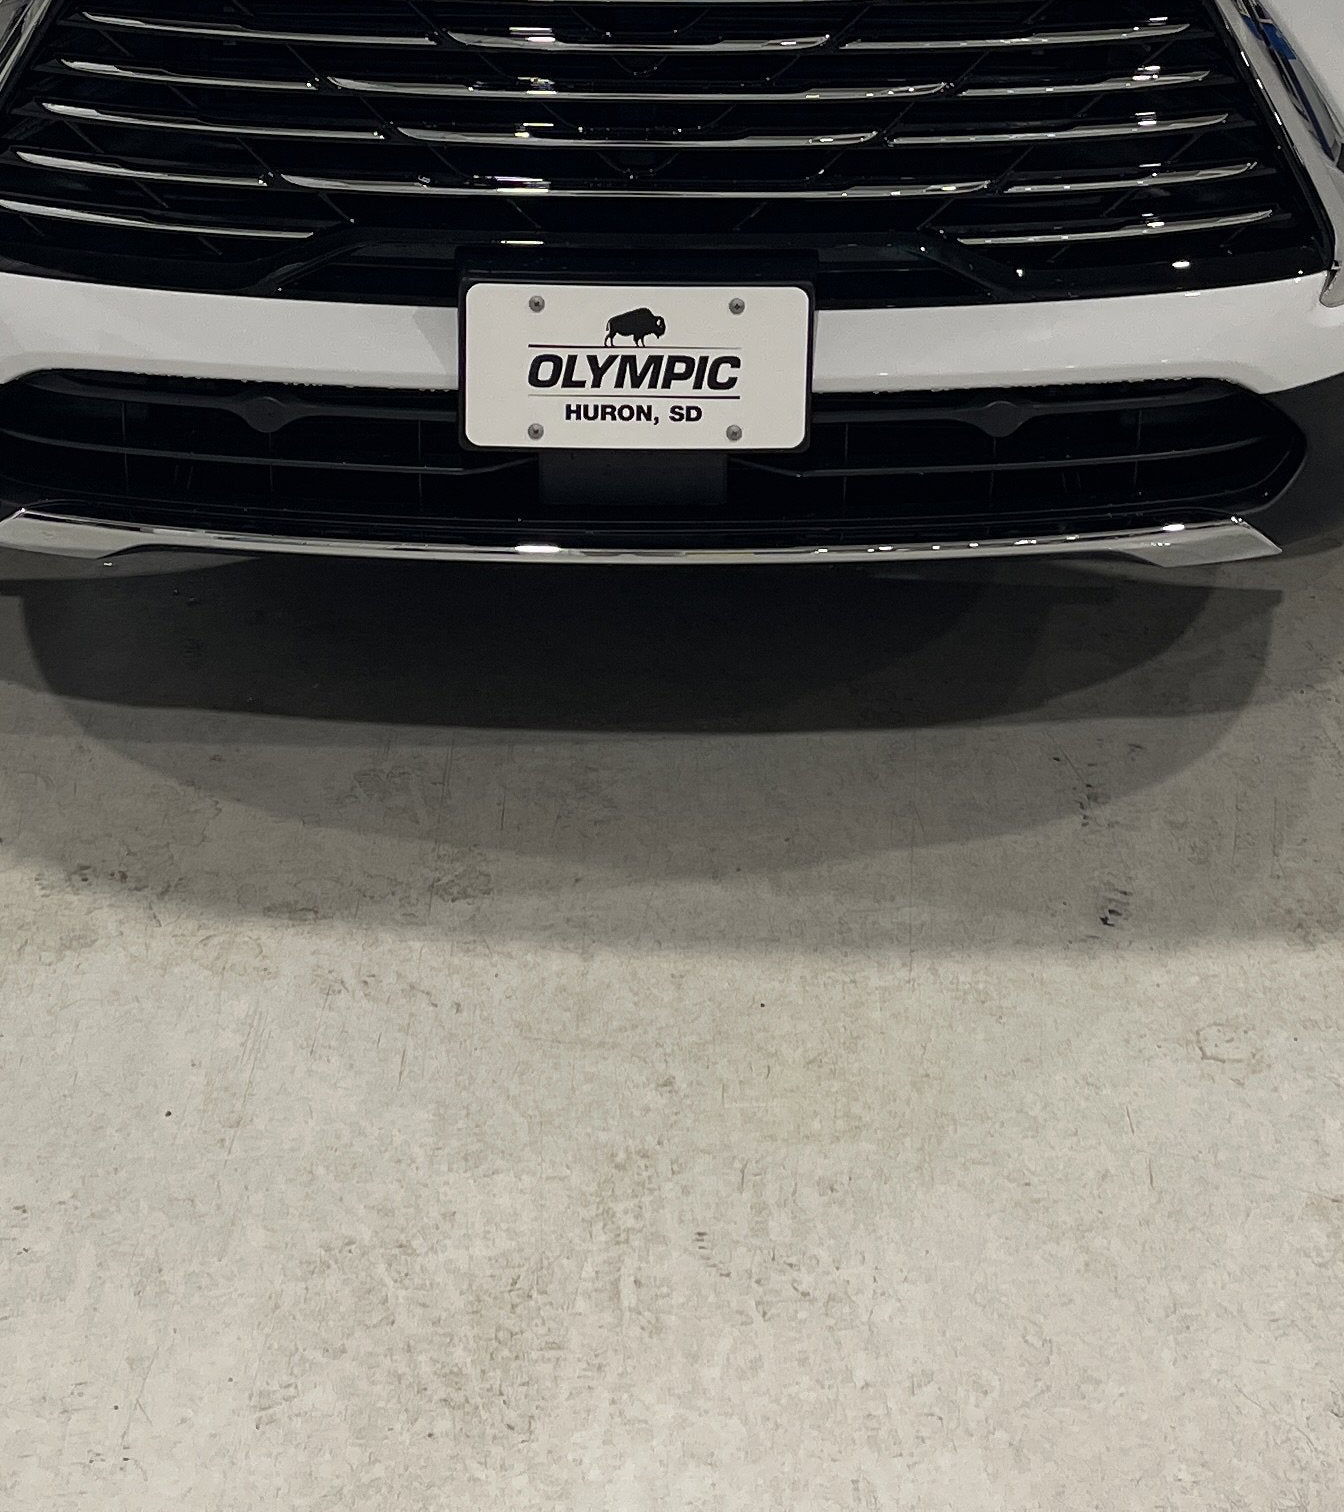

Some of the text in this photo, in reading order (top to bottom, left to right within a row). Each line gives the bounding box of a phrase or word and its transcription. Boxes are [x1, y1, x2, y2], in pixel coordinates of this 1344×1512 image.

[528, 354, 741, 390] OLYMPIC
[565, 403, 703, 426] HURON, SD
